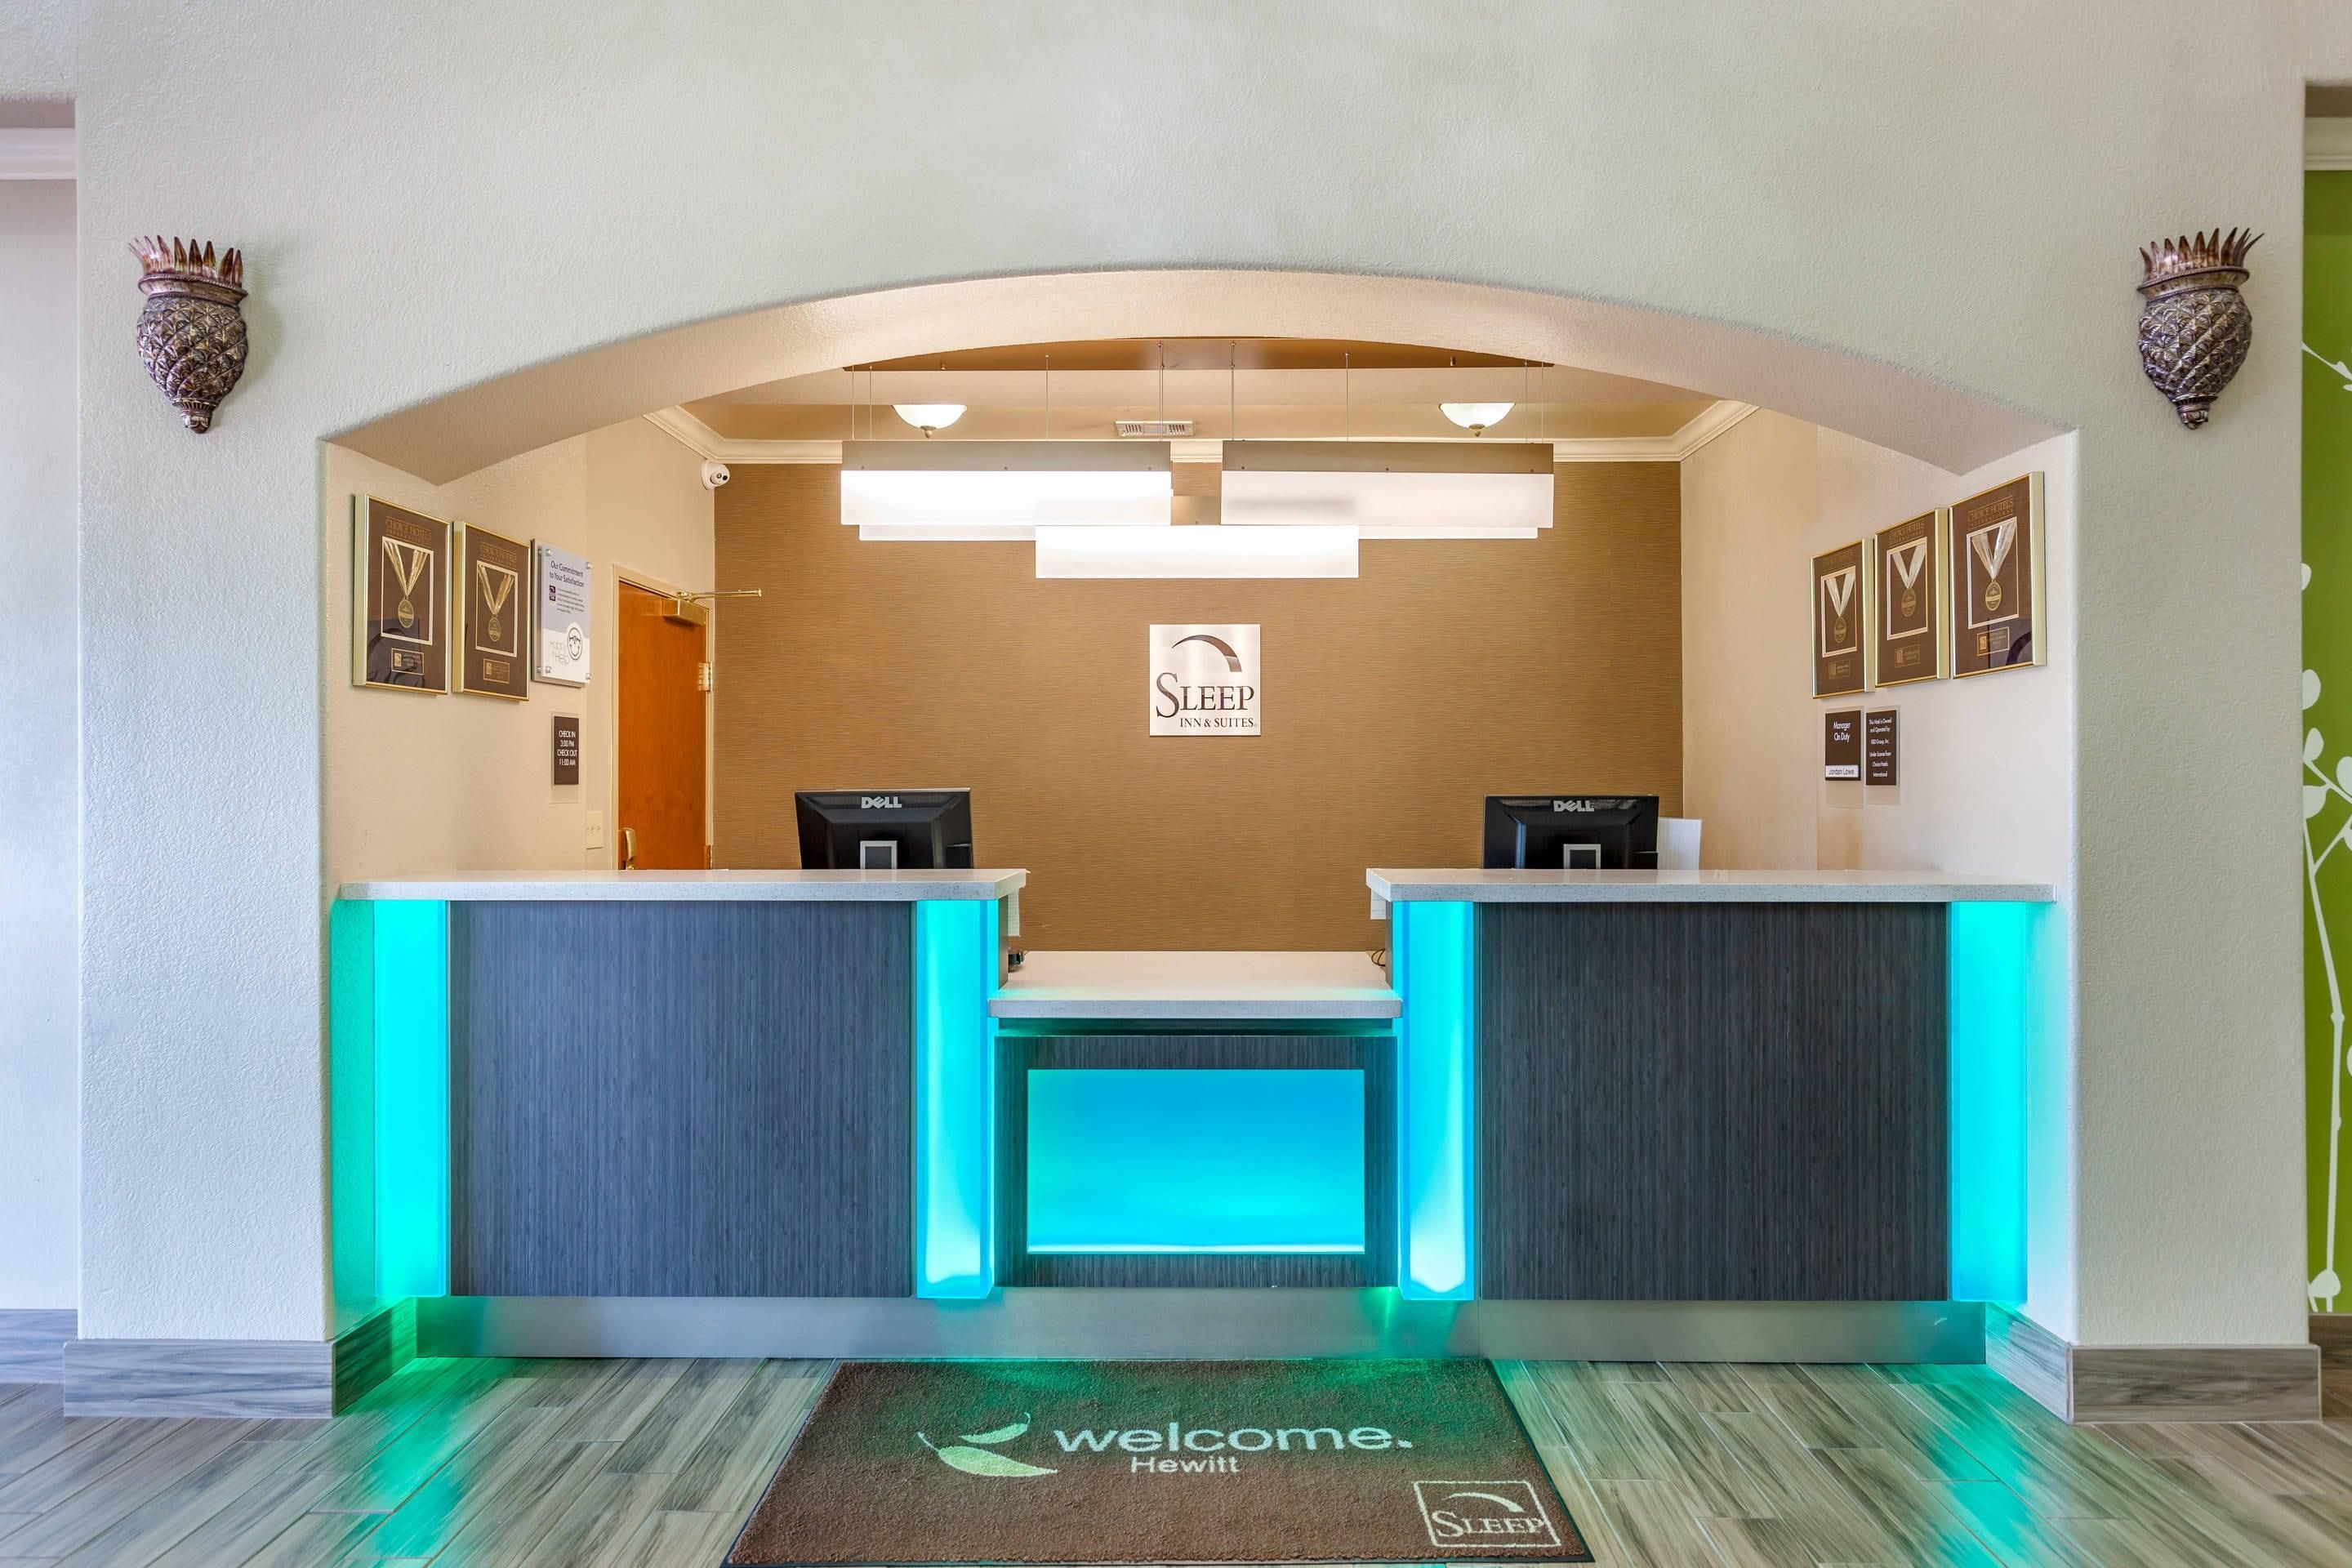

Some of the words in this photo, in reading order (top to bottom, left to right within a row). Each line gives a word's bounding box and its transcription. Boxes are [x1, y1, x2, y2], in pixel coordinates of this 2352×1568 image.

[1967, 507, 1991, 523] CHOICE
[1993, 498, 2013, 512] HOTELS
[385, 519, 408, 532] CHOICE
[409, 526, 431, 540] HOTELS
[550, 560, 559, 569] Our
[559, 563, 584, 577] Commitment
[555, 572, 563, 581] Your
[563, 574, 585, 587] Satisfaction
[1156, 672, 1254, 718] SLEEP
[1180, 718, 1201, 728] INN
[1204, 718, 1212, 728] &
[1214, 718, 1254, 728] SUITES
[1833, 721, 1851, 732] Manager
[559, 730, 572, 738] CHECK
[1833, 732, 1841, 742] On
[1841, 732, 1851, 743] Duty
[861, 795, 902, 809] DELL
[1553, 800, 1594, 813] DELL
[1131, 1456, 1241, 1473] Hewitt
[1432, 1511, 1544, 1537] SLEEP
